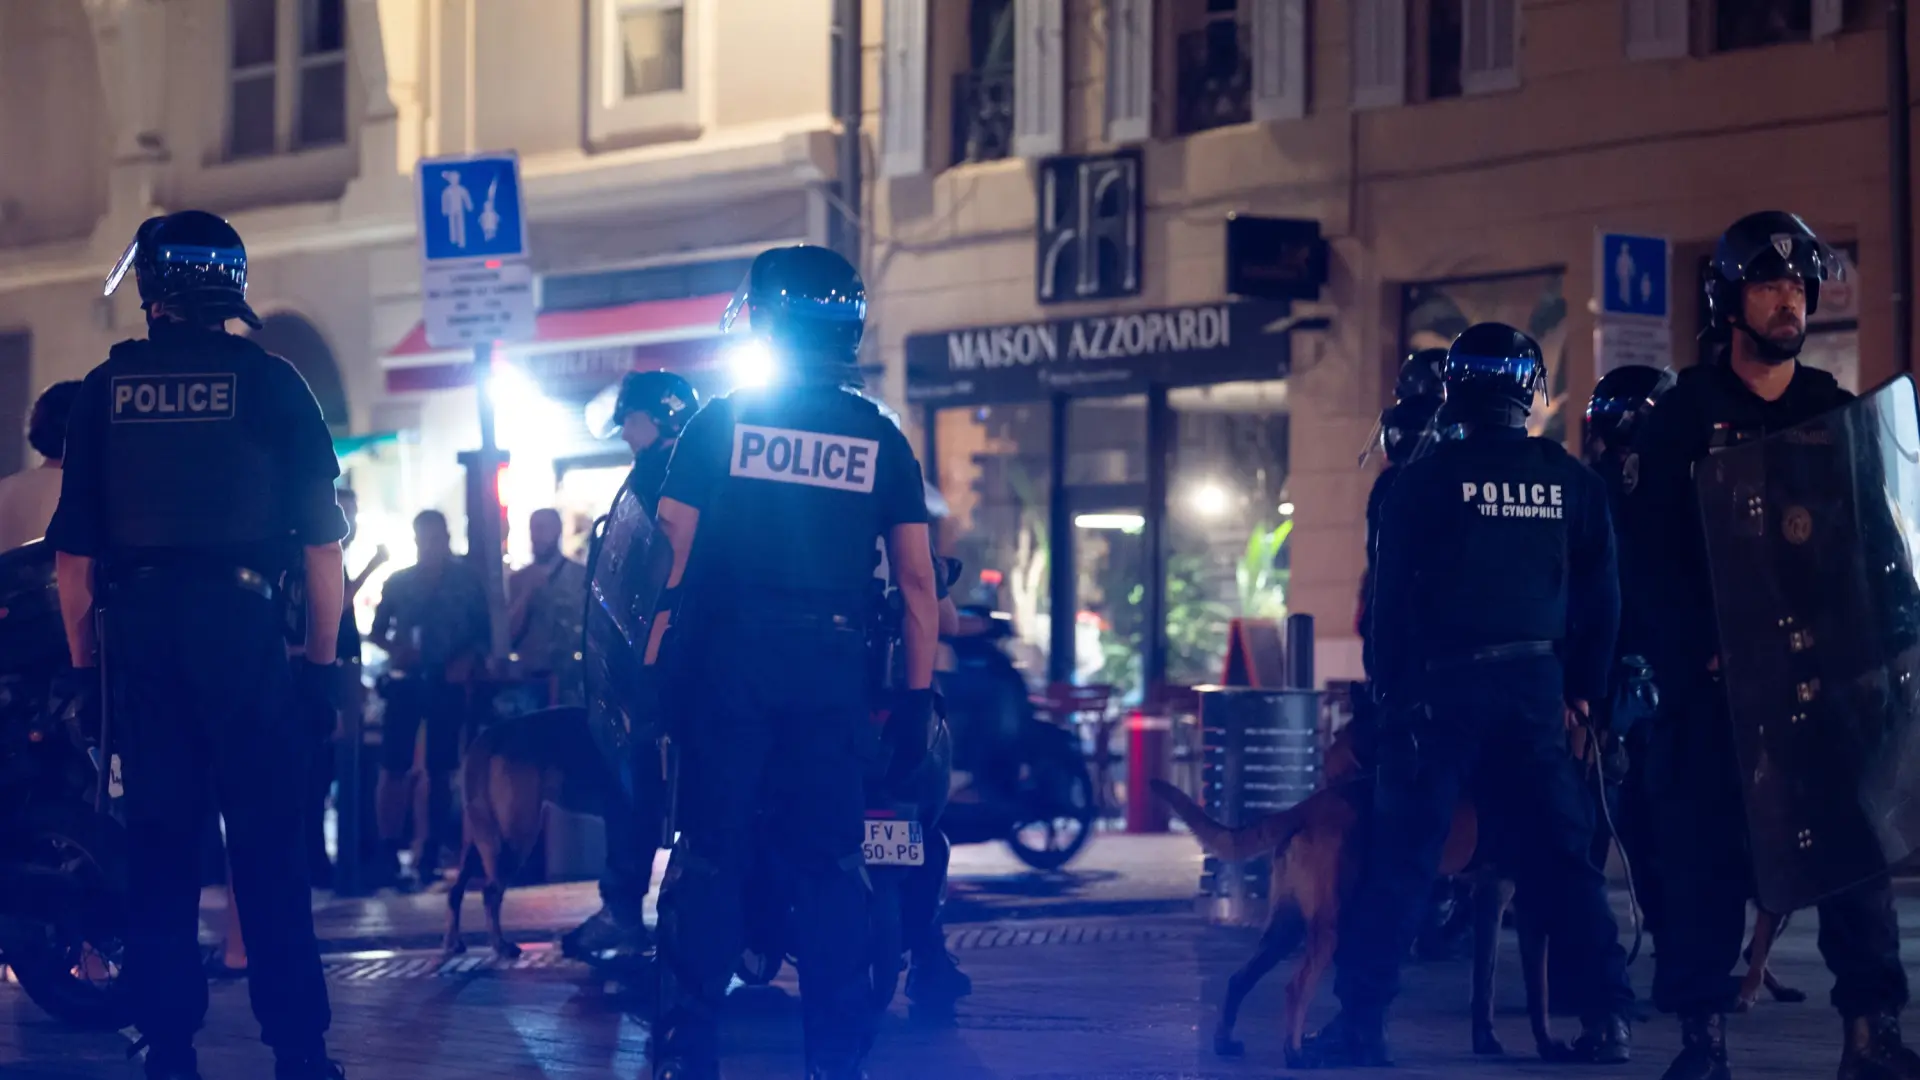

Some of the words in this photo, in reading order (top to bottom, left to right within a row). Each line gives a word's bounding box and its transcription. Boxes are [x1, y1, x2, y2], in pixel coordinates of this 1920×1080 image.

[948, 325, 1058, 370] MAISON
[1068, 307, 1230, 358] AZZOPARDI
[115, 383, 229, 413] POLICE
[740, 432, 868, 484] POLICE
[1462, 482, 1562, 505] POLICE
[1502, 505, 1563, 519] CYNOPHILE
[864, 843, 919, 861] 50-PG
